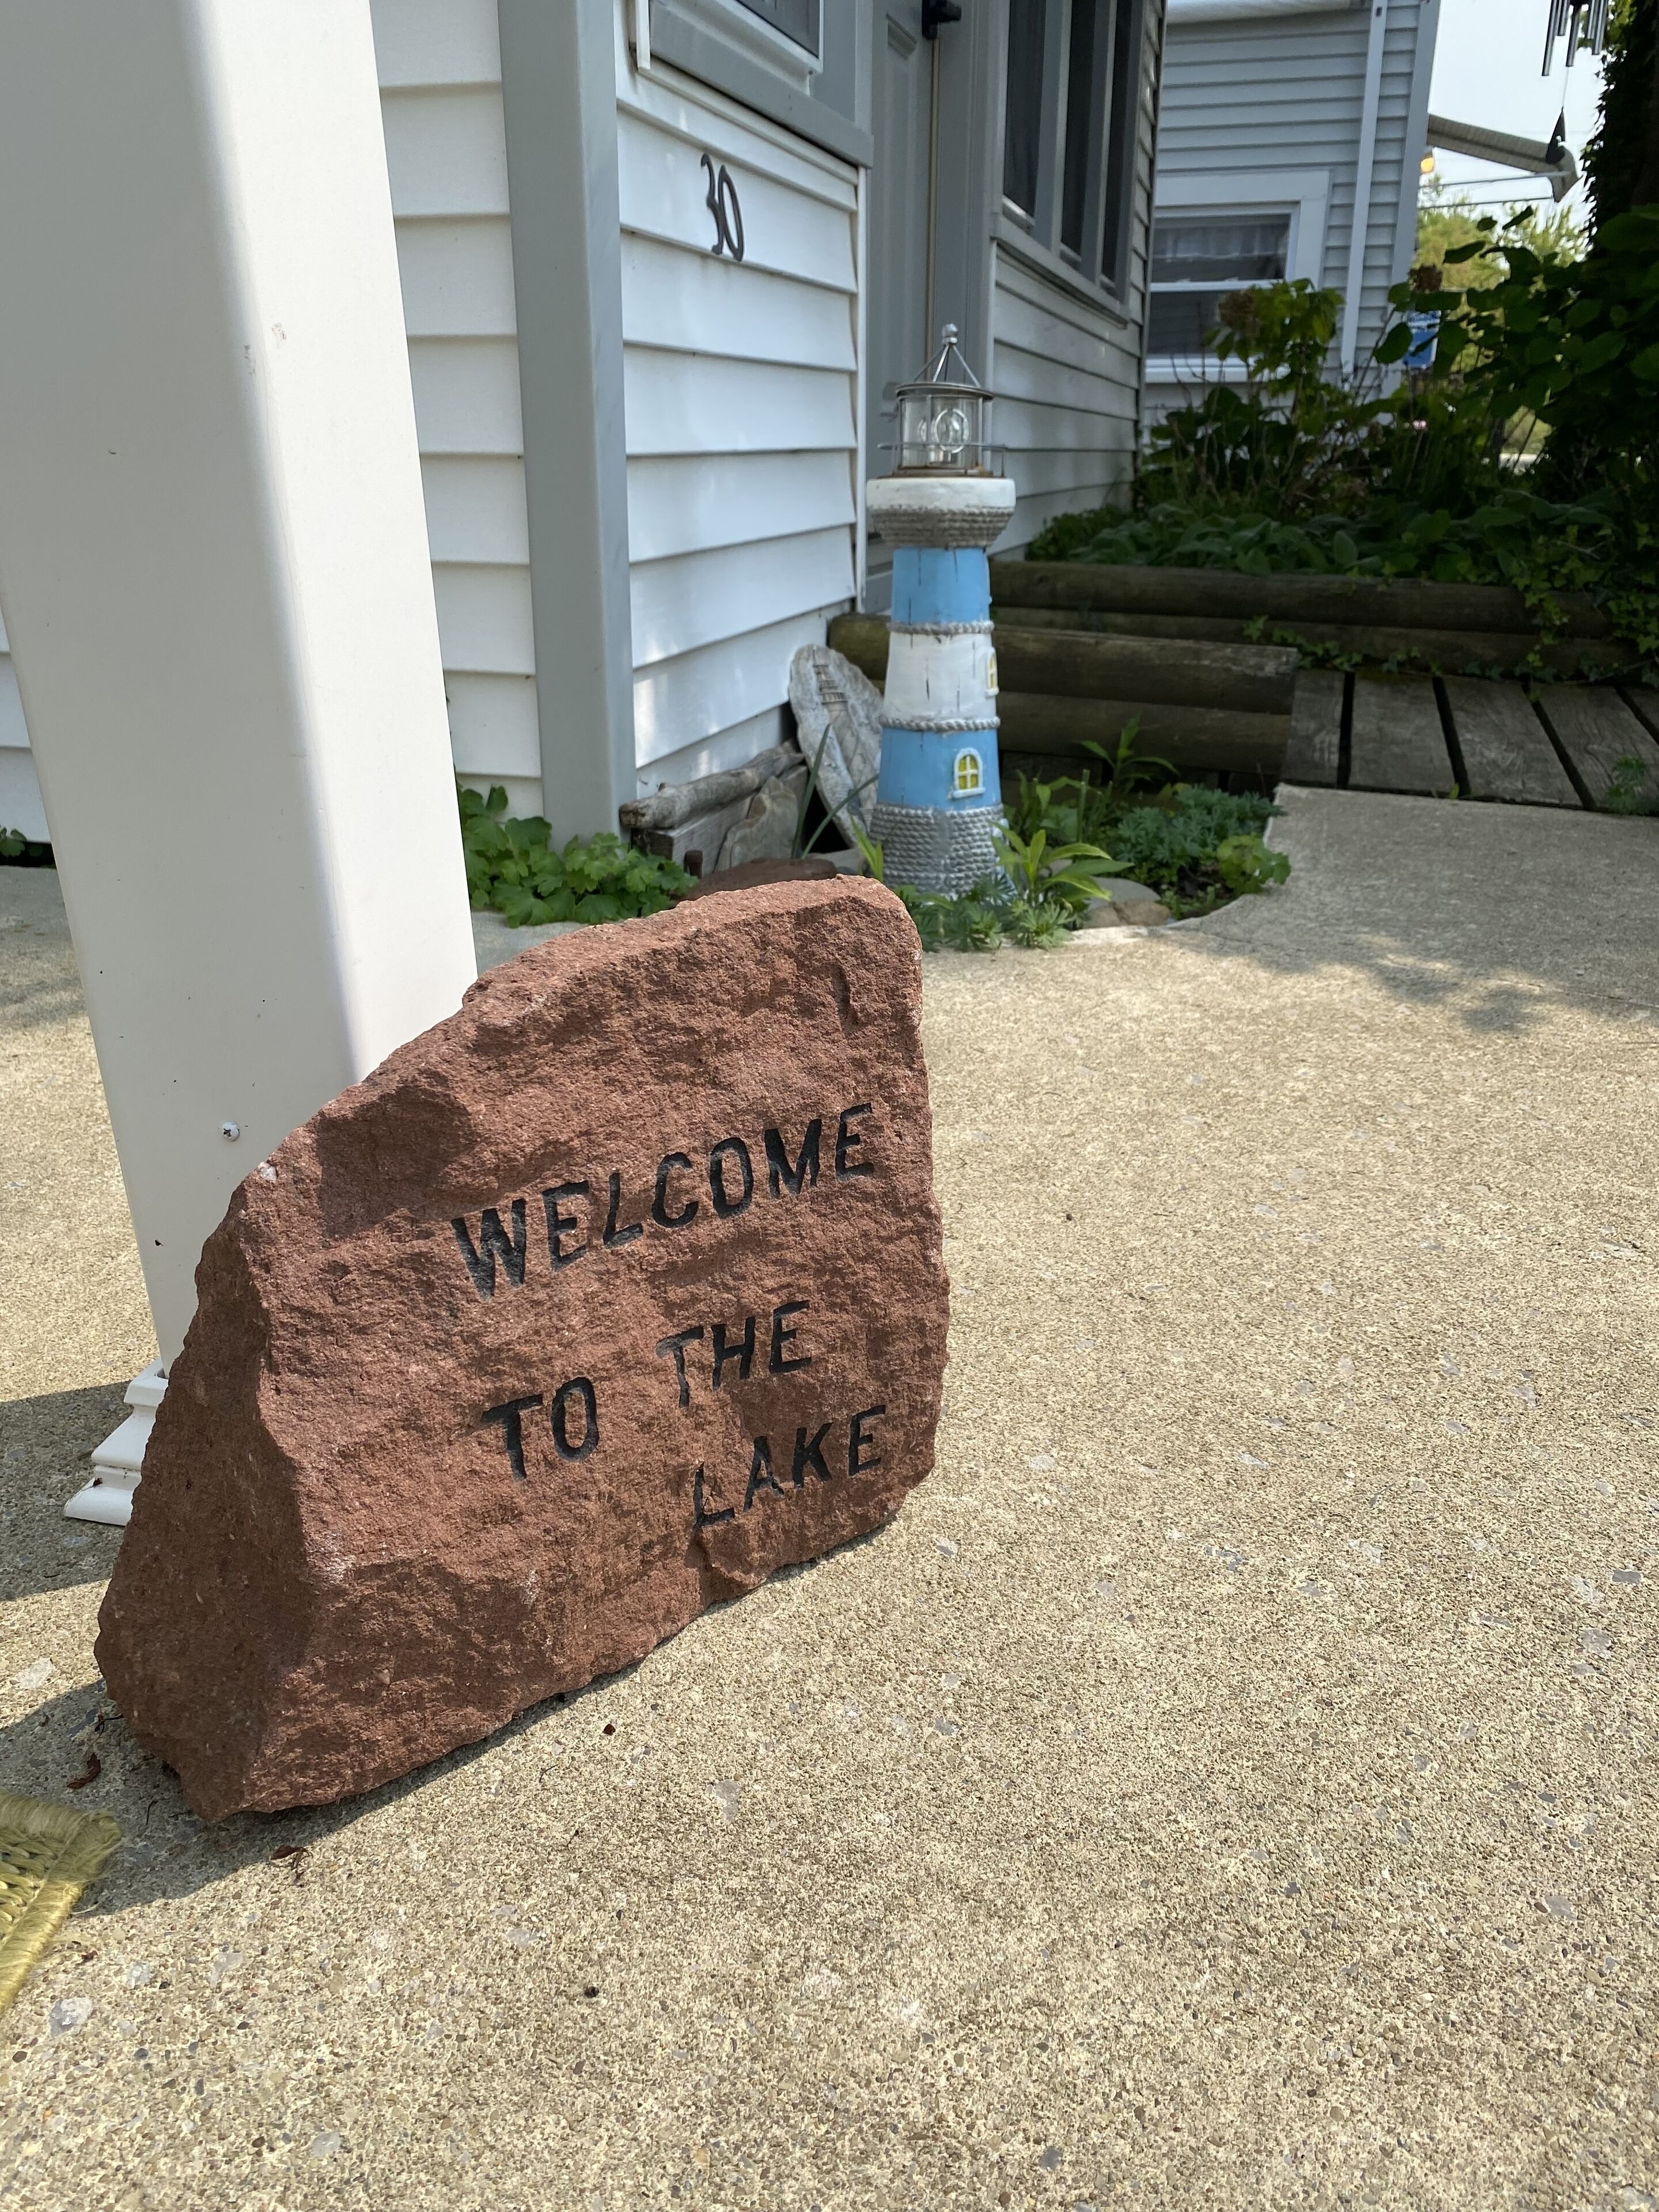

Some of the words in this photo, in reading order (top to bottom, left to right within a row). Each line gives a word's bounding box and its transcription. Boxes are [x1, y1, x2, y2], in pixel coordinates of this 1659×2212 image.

[700, 153, 745, 262] 30
[450, 1101, 874, 1301] WELCOME
[480, 1376, 600, 1482] TO
[655, 1300, 813, 1408] THE
[694, 1404, 887, 1530] LAKE
